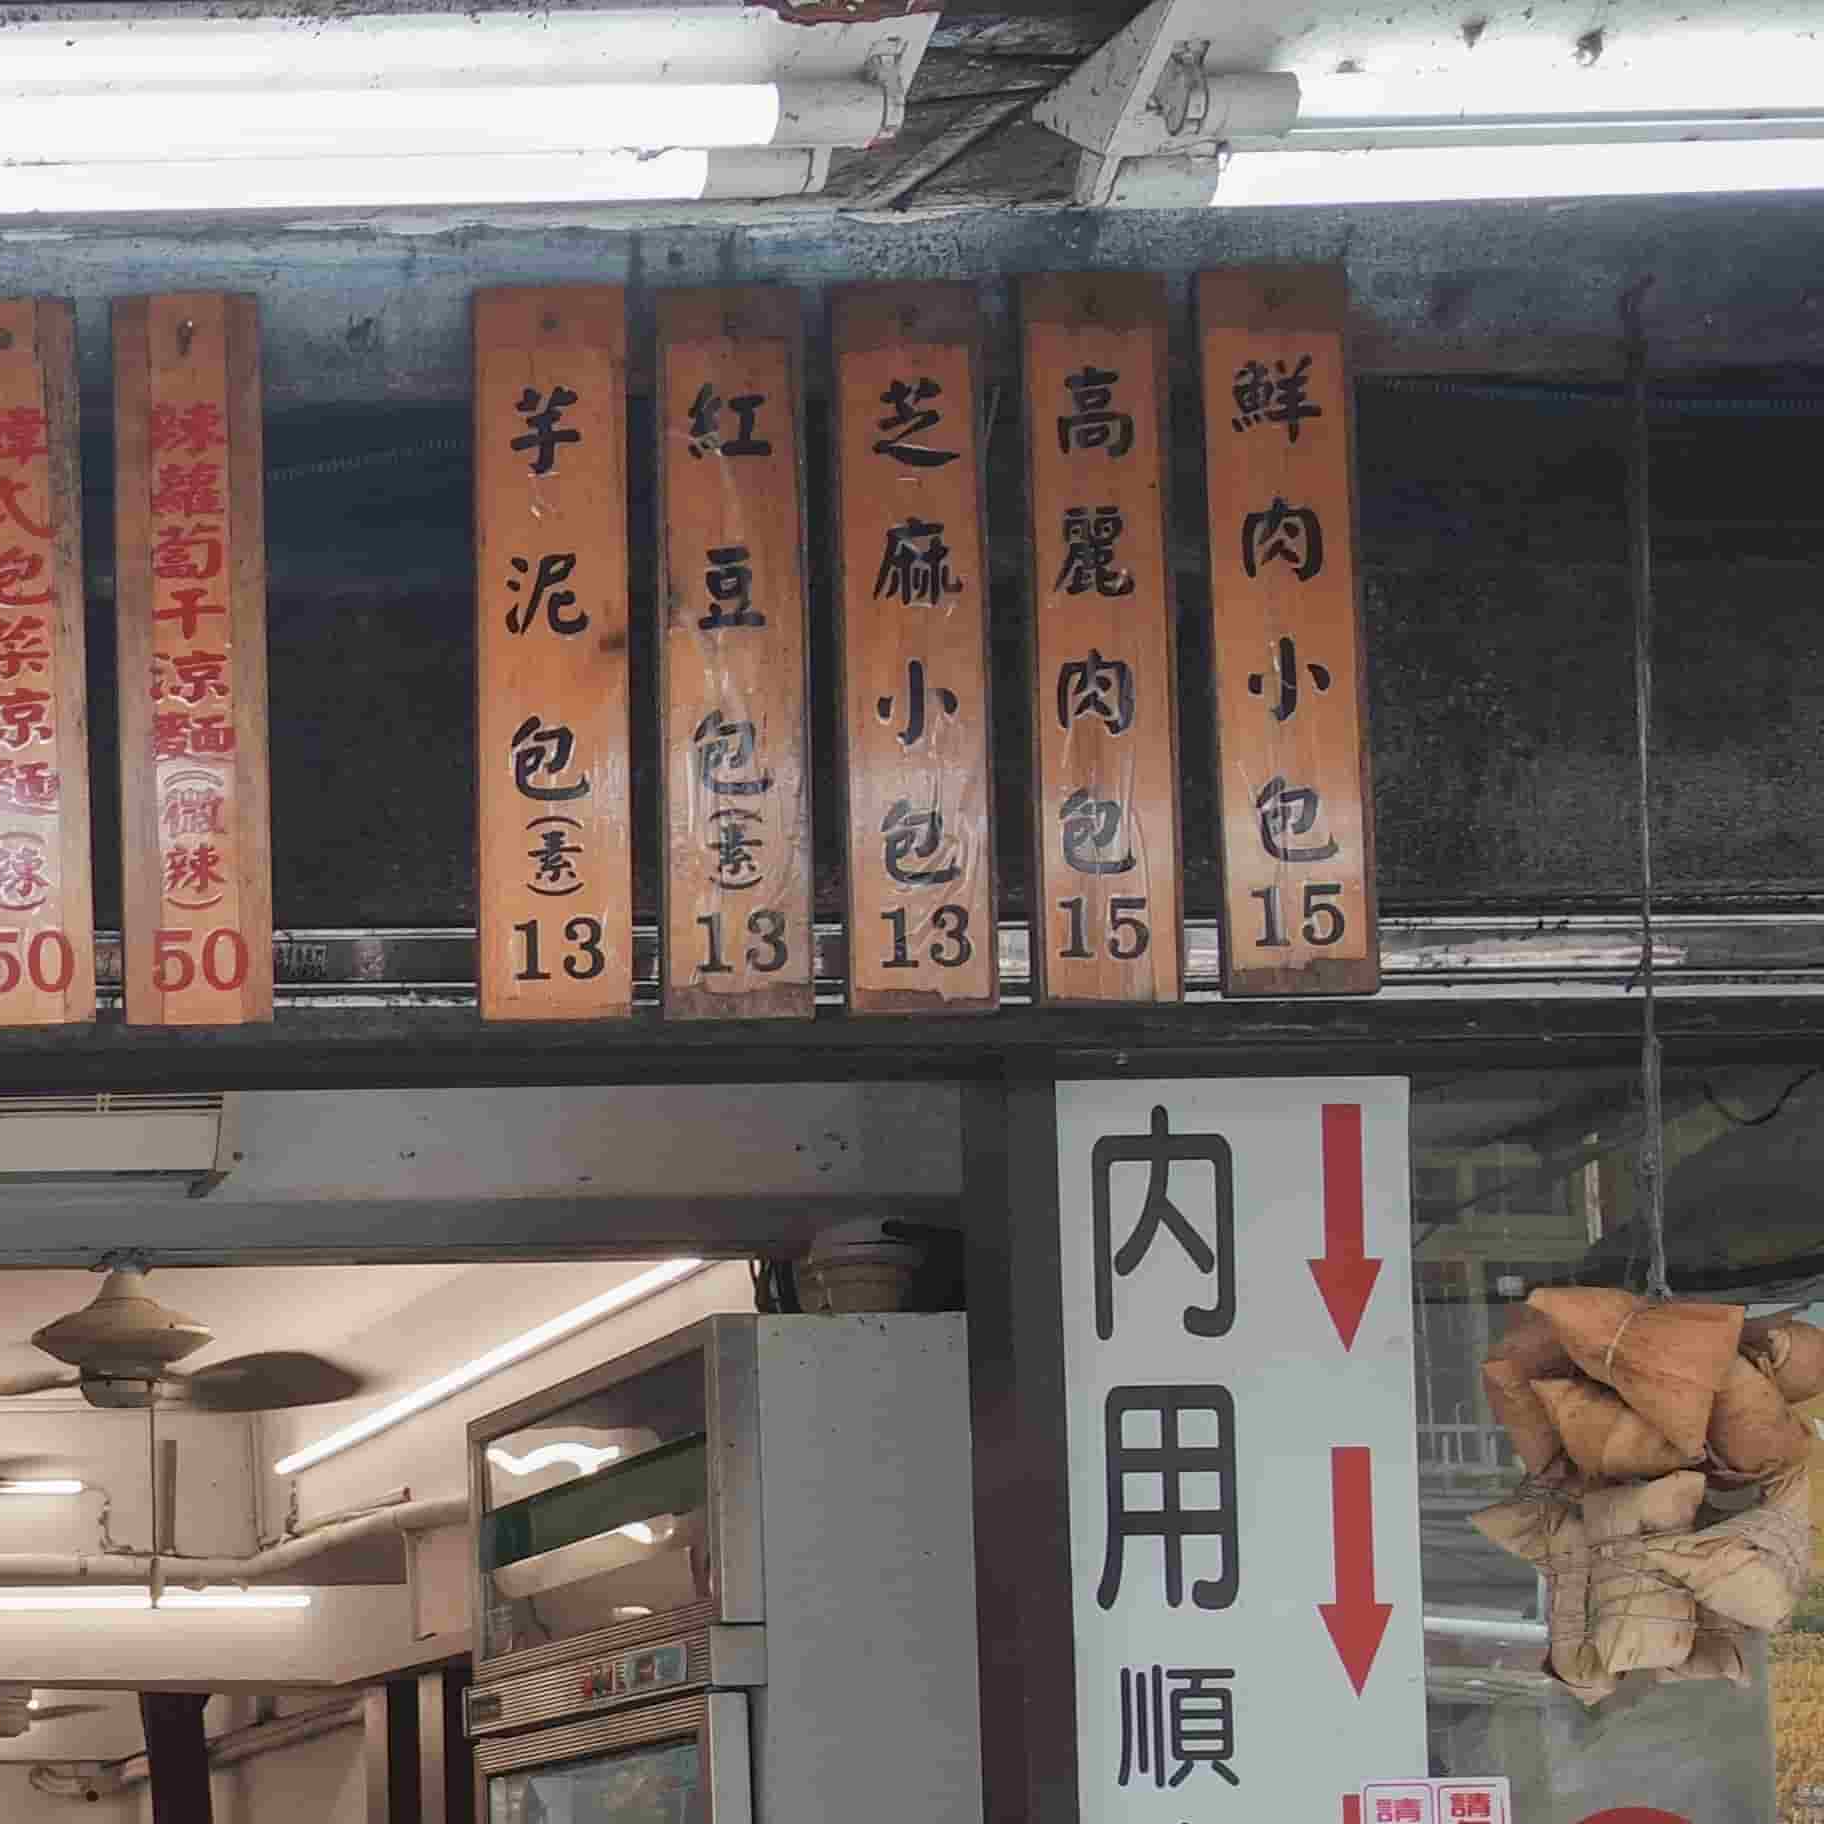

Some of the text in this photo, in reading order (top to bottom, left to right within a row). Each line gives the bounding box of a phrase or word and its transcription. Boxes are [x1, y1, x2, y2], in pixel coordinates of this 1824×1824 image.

[871, 379, 972, 969] 芝麻小包 13
[1056, 367, 1150, 961] 高麗肉包 15
[1230, 356, 1347, 948] 鮮肉小包 15
[152, 929, 249, 993] 50
[513, 917, 605, 980] 13
[695, 909, 788, 973] 13
